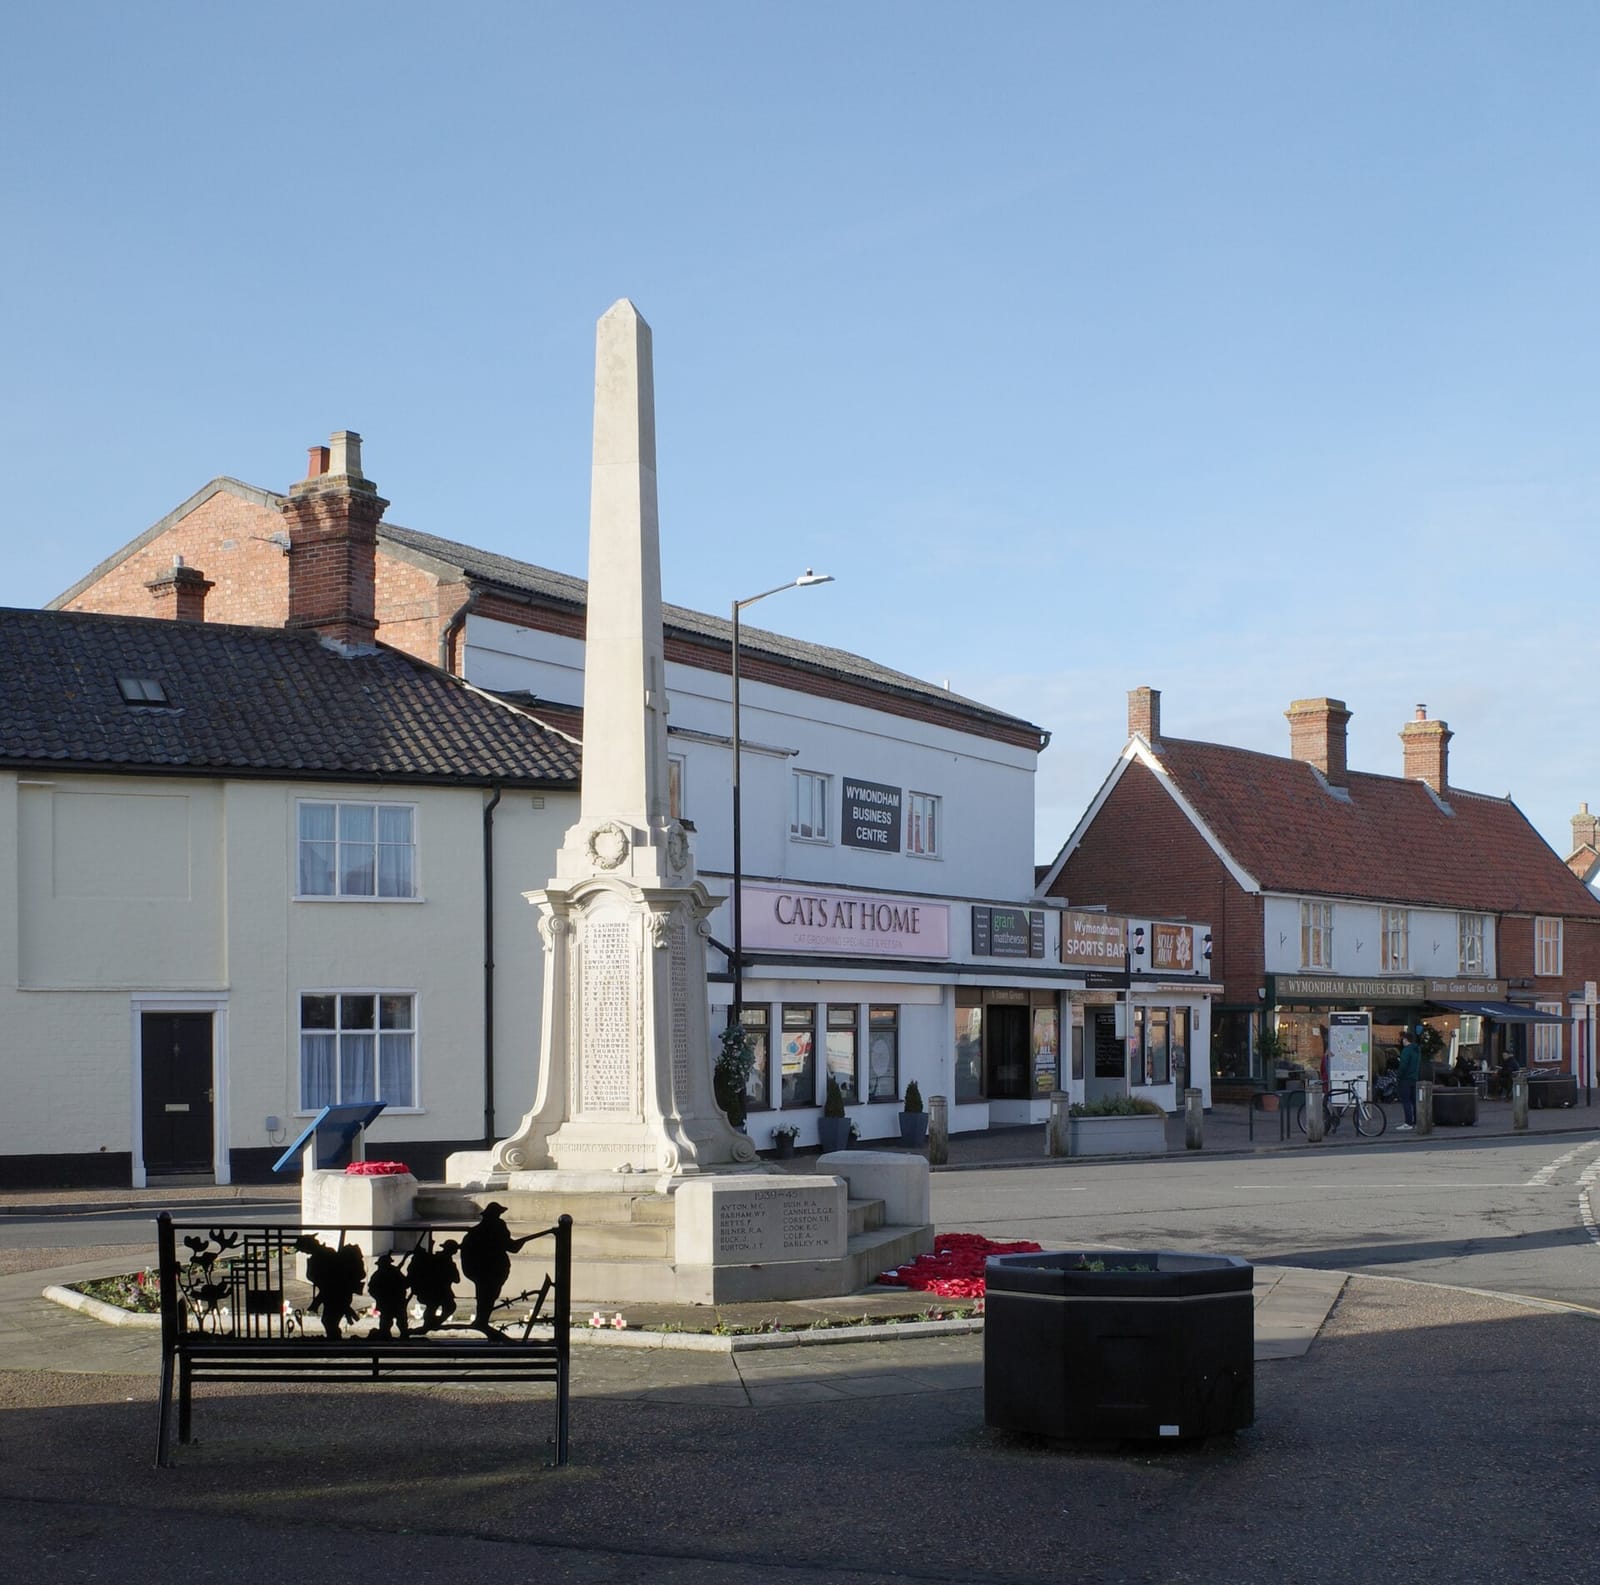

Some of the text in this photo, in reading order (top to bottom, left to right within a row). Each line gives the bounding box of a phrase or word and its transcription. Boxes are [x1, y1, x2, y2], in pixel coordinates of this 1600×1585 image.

[846, 785, 899, 807] WYMONDHAM
[852, 806, 892, 824] BUSINESS
[856, 826, 888, 843] CENTRE
[774, 895, 921, 934] CATS AT HOME
[994, 913, 1015, 931] grant
[1073, 920, 1120, 937] Wymondham
[1066, 939, 1125, 958] SPORTS BAR
[1288, 980, 1344, 993] WYMONDHAM
[1346, 982, 1386, 995] ANTIQUES
[1386, 983, 1414, 995] CENTRE
[1432, 981, 1448, 992] Town
[1450, 982, 1466, 992] Green
[1468, 982, 1485, 993] Garden
